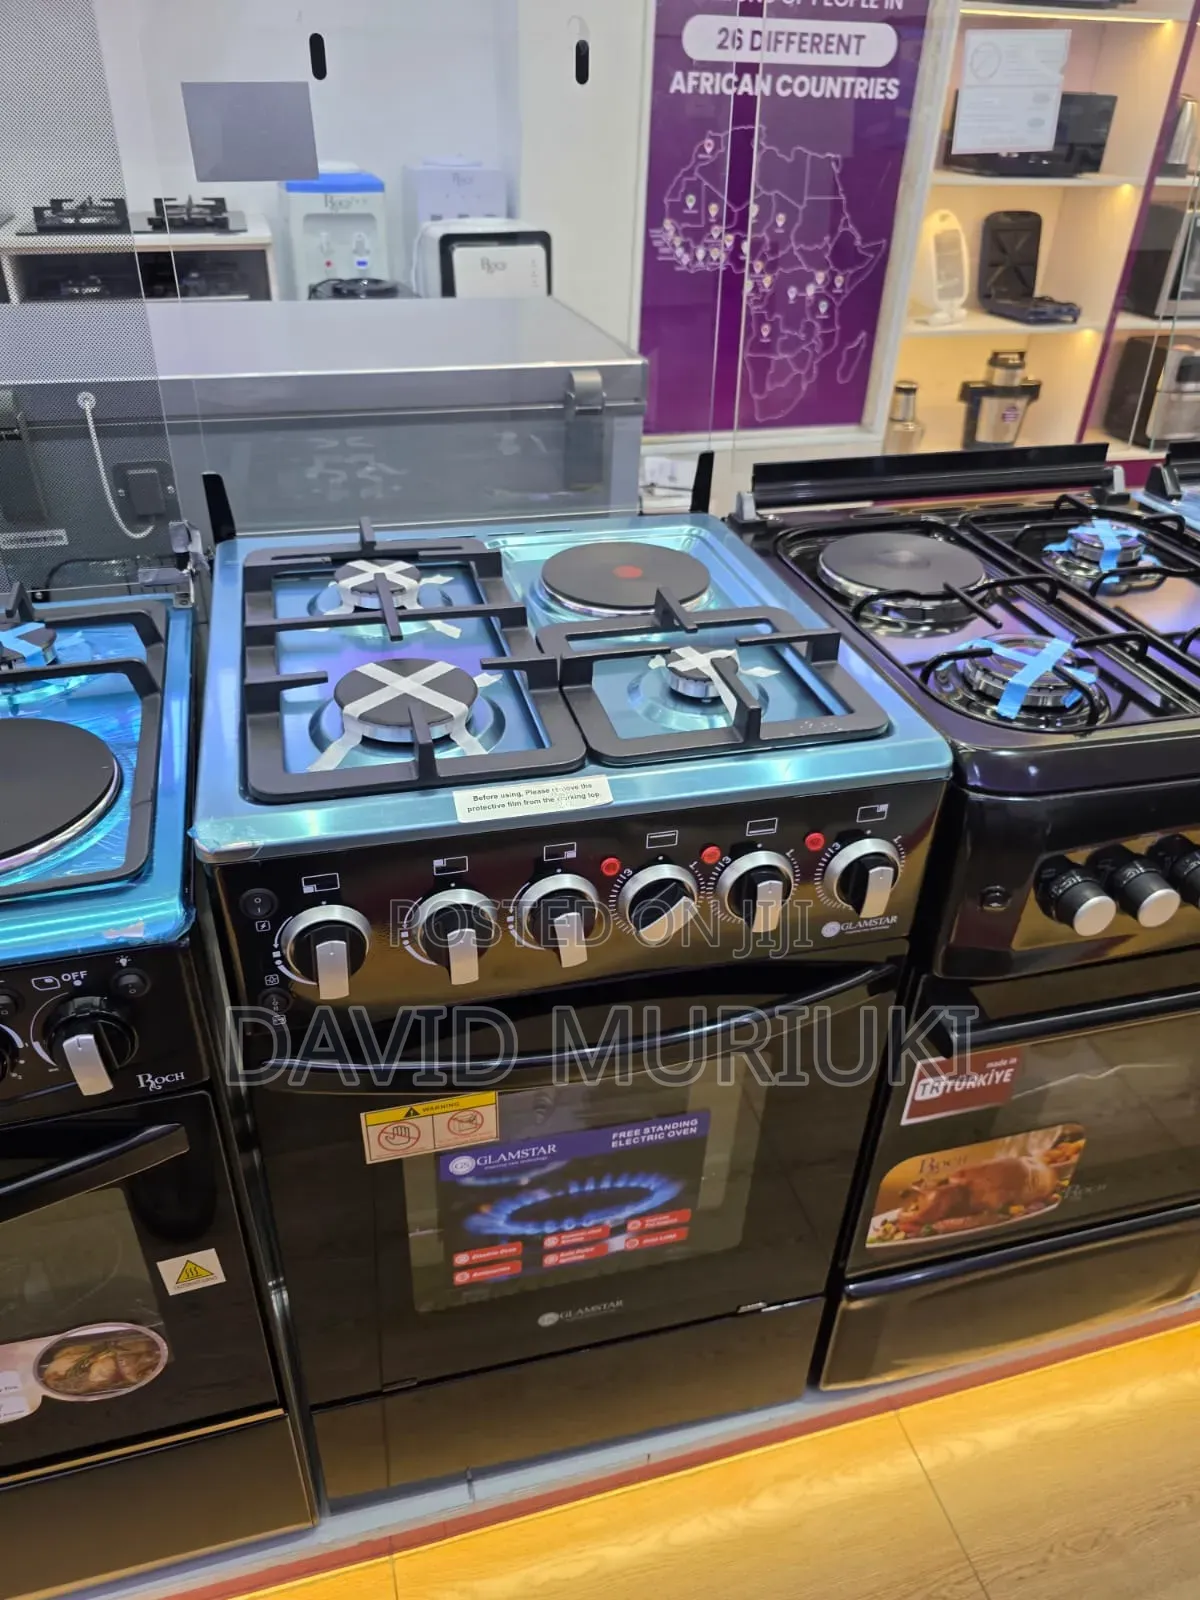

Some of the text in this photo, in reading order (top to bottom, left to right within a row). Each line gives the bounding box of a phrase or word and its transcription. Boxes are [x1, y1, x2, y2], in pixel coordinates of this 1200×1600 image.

[716, 28, 866, 55] 26 DIFFERENT
[669, 71, 901, 100] AFRICAN COUNTRIES
[467, 802, 506, 813] protective
[507, 800, 522, 808] film
[523, 798, 541, 806] from
[543, 796, 555, 804] the
[473, 793, 499, 802] Before
[525, 788, 549, 796] Please
[840, 915, 898, 931] GLAMSTAR
[61, 970, 88, 982] OFF
[422, 1101, 460, 1113] WARNING
[611, 1127, 698, 1148] ELECTRIC OVEN
[612, 1118, 699, 1140] FREE STANDING
[477, 1144, 557, 1166] GLAMSTAR
